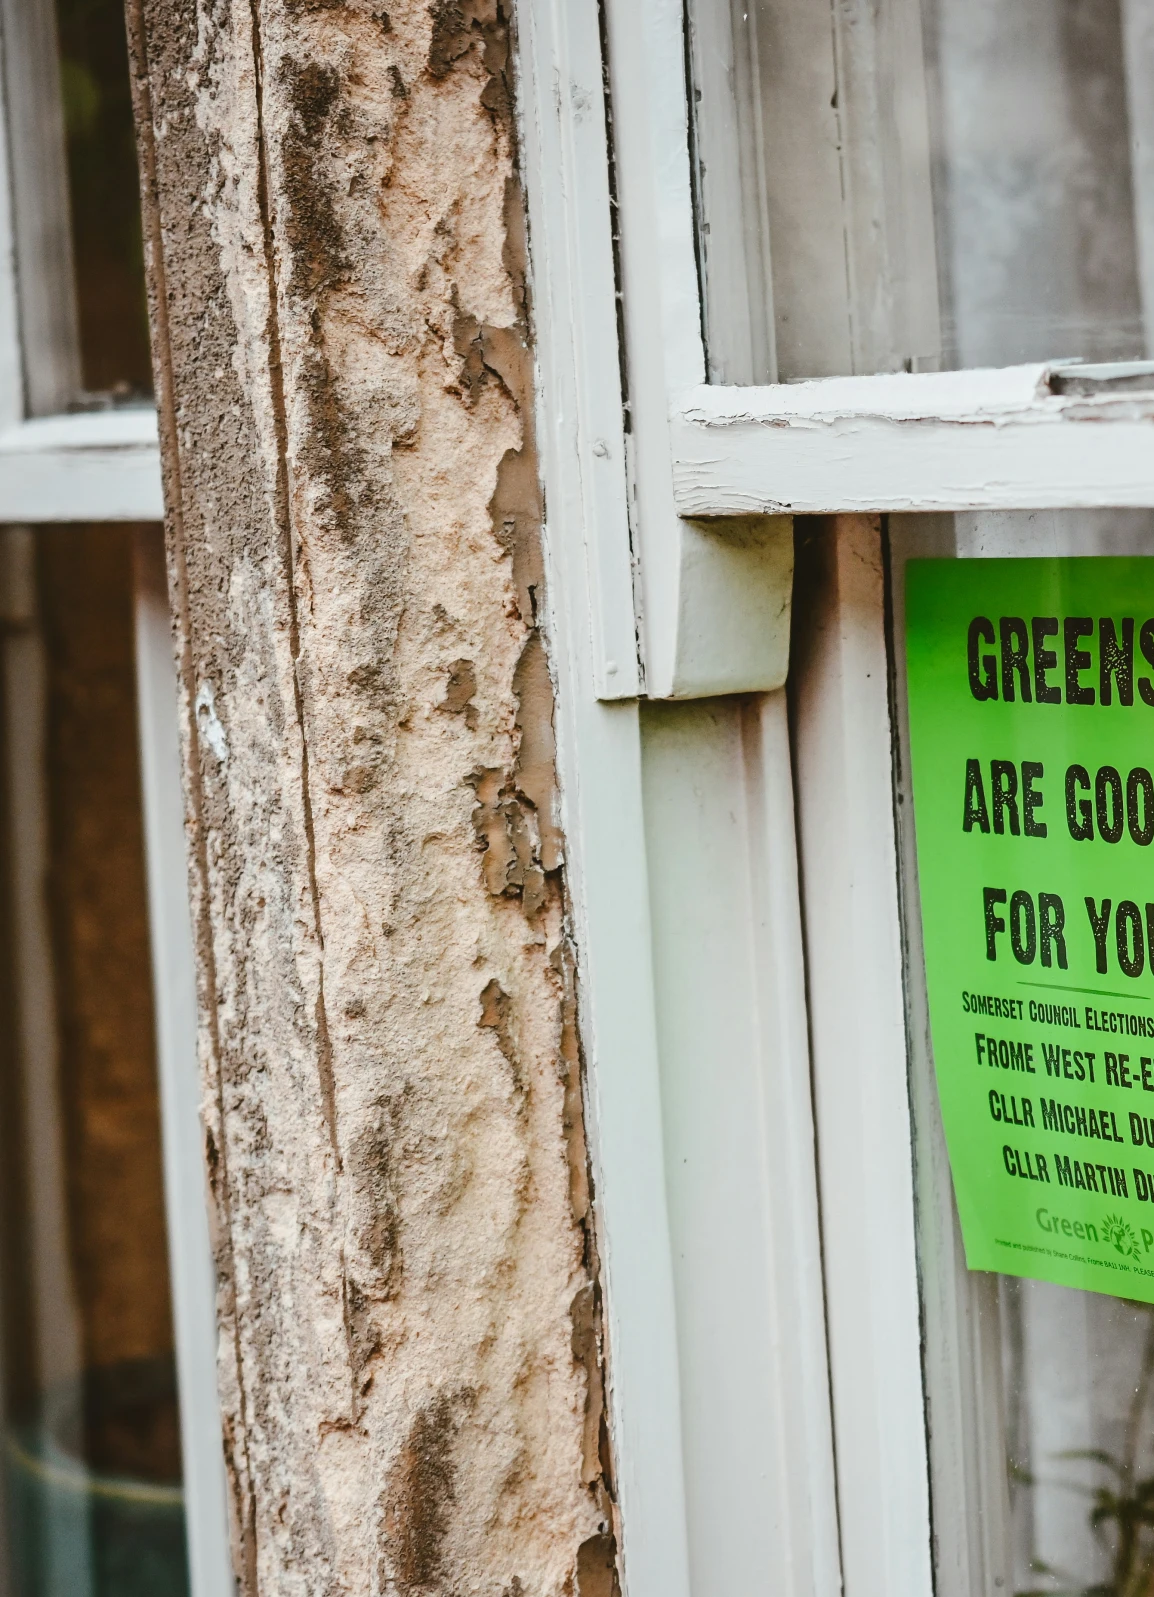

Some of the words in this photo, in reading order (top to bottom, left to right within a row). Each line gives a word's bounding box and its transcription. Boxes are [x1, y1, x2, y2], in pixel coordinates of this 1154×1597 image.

[962, 759, 1048, 838] ARE
[983, 887, 1068, 970] FOR
[989, 1089, 1035, 1127] CLLR
[1003, 1145, 1050, 1183] CLLR
[1035, 1207, 1099, 1243] Green
[1087, 1258, 1103, 1266] Frome
[1133, 1267, 1154, 1277] PLEASE
